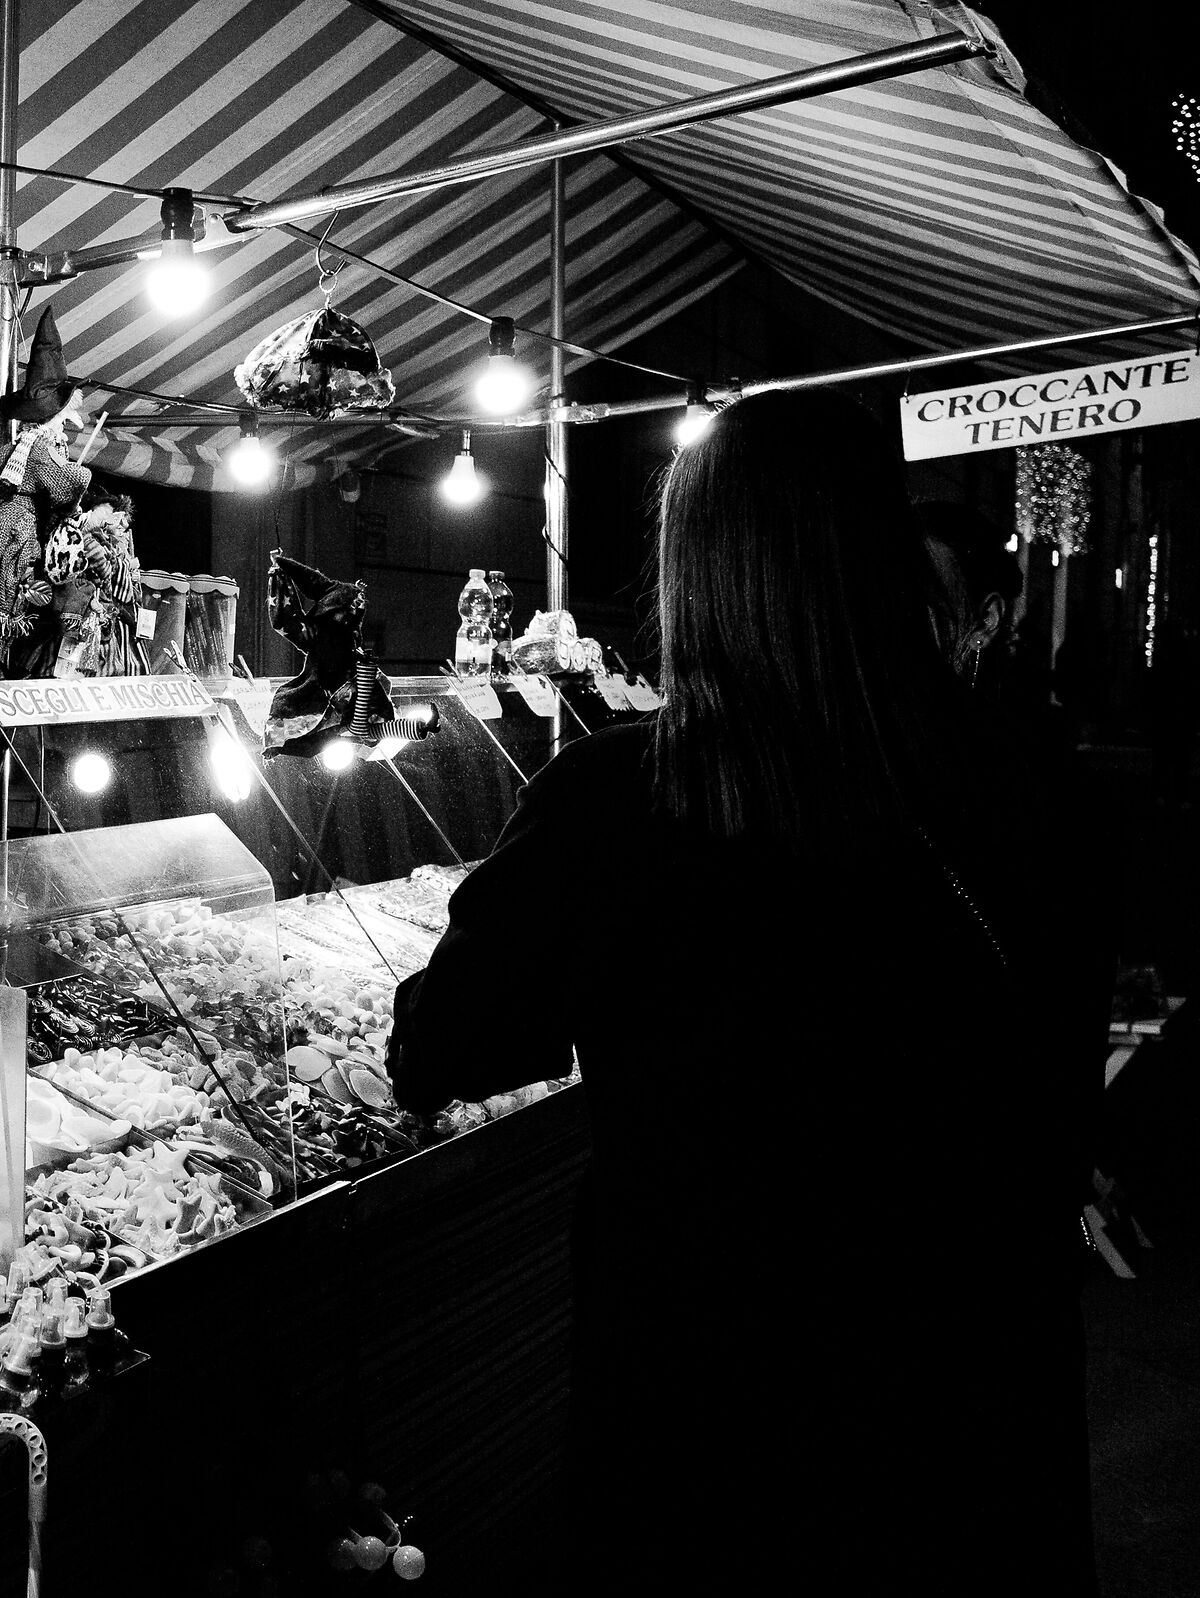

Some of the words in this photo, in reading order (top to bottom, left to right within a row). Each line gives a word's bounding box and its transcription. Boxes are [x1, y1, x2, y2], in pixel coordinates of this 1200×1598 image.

[917, 358, 1191, 423] CROCCANTE
[965, 398, 1142, 445] TENERO
[91, 684, 111, 712] E
[108, 679, 209, 712] MISCHIA
